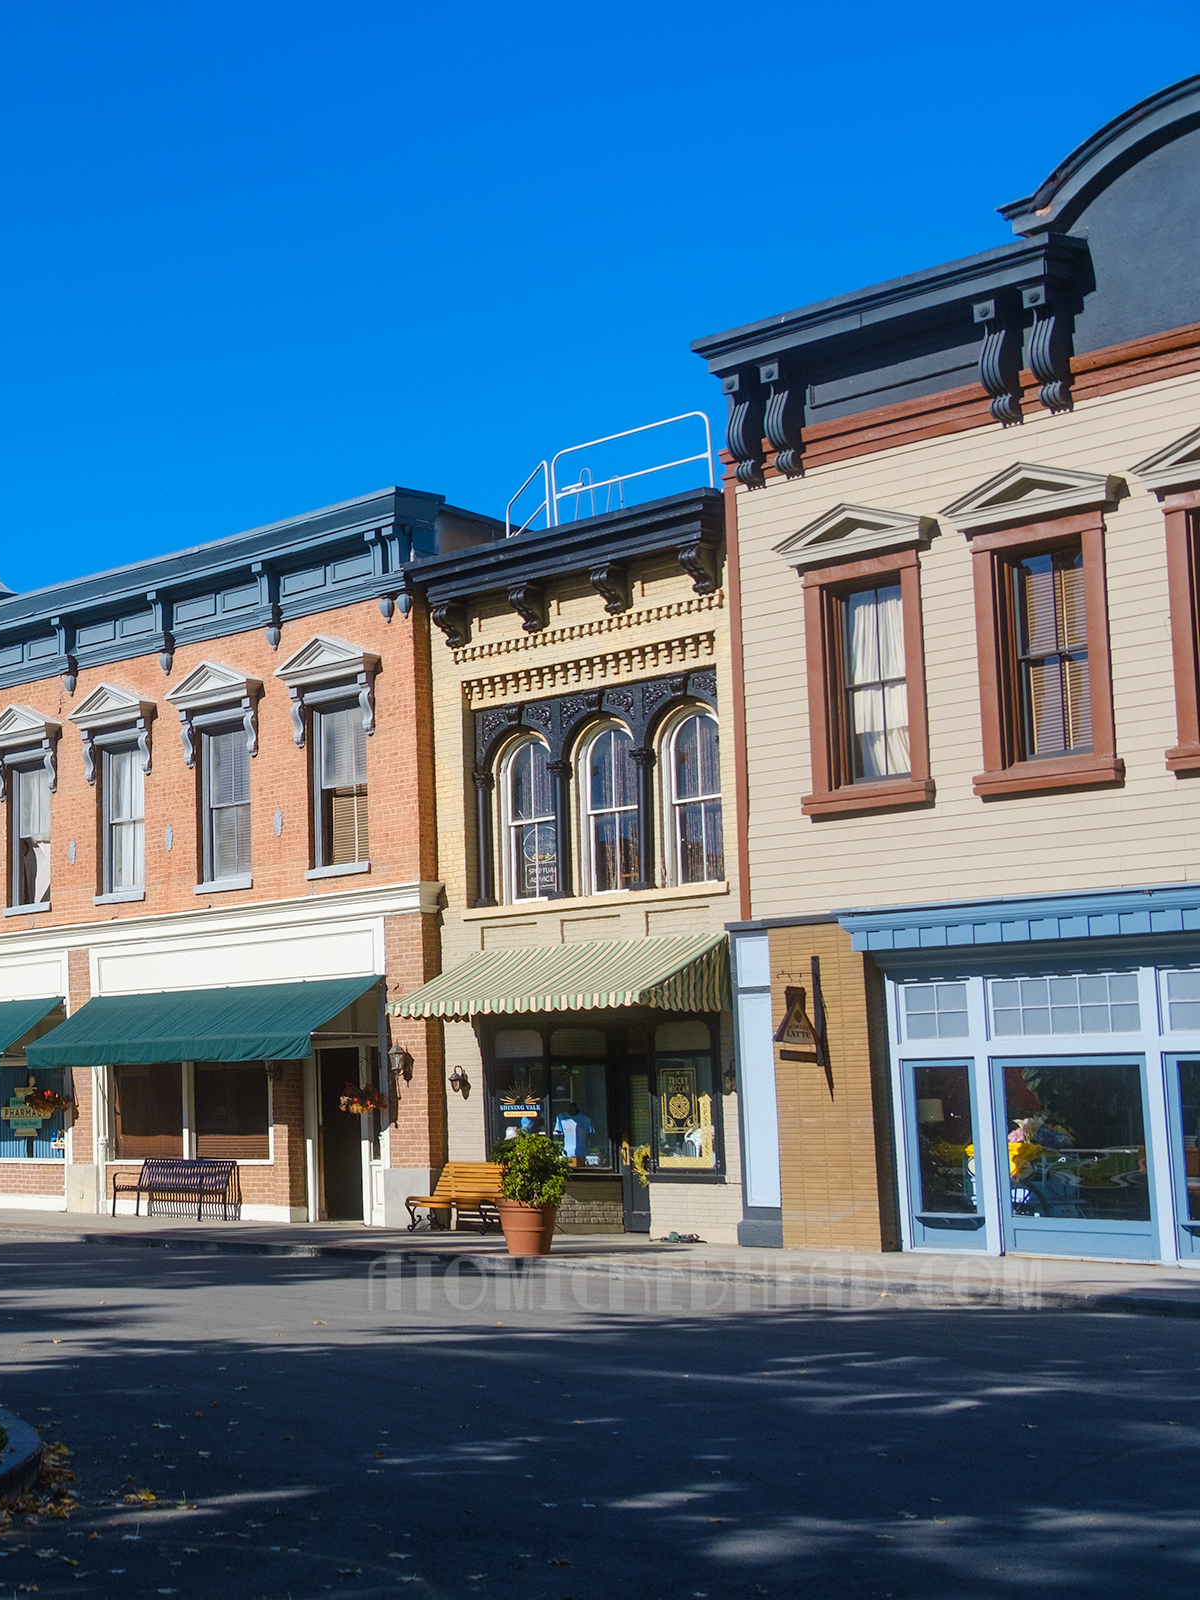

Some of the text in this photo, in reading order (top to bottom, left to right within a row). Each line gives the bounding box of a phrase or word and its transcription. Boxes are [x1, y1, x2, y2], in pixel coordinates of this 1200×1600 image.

[528, 867, 555, 876] SPRTUA
[786, 1029, 811, 1038] LATTE
[668, 1077, 689, 1085] TRICKY
[667, 1085, 690, 1093] WICCAN
[4, 1108, 46, 1117] PHARMA
